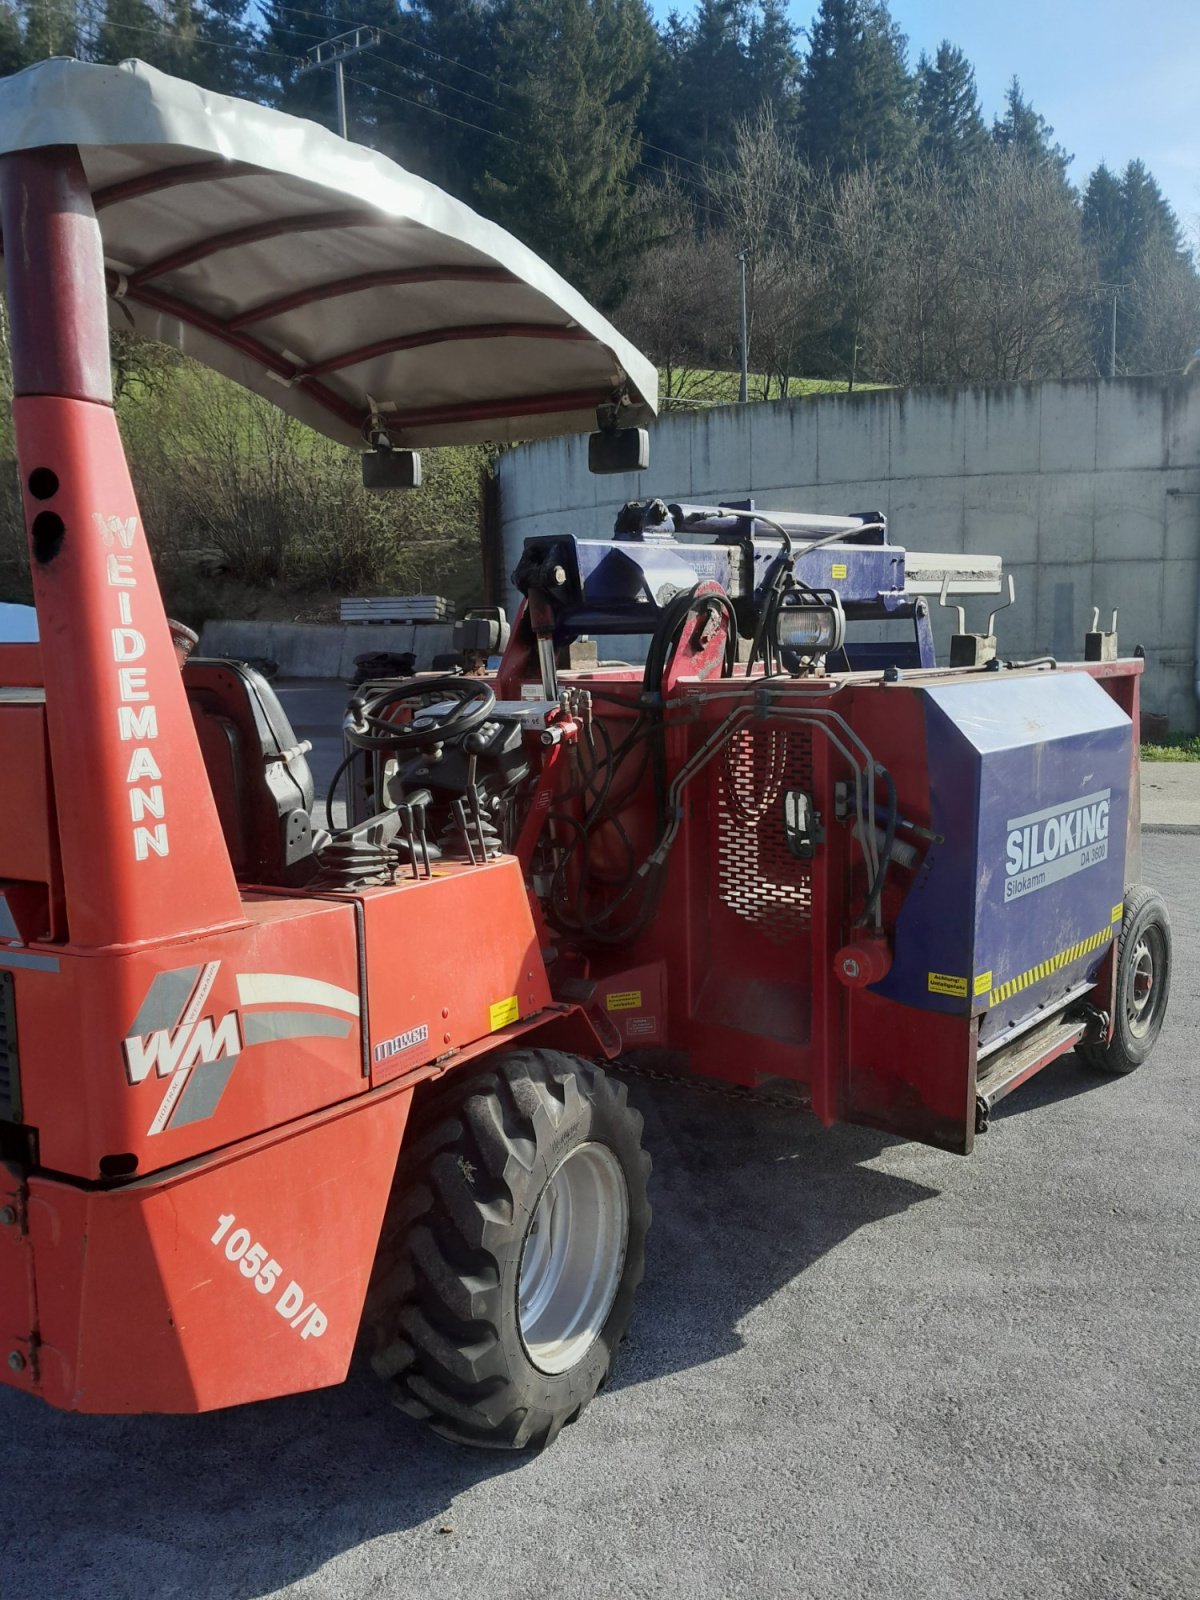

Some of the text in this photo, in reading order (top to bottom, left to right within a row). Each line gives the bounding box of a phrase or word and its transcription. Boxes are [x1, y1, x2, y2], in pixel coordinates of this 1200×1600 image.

[92, 512, 169, 861] WEIDEMANN
[1005, 800, 1109, 876] SILOKING
[1080, 851, 1090, 867] DA
[1006, 872, 1046, 897] Silokamm
[210, 1213, 328, 1340] 1055 D/P
